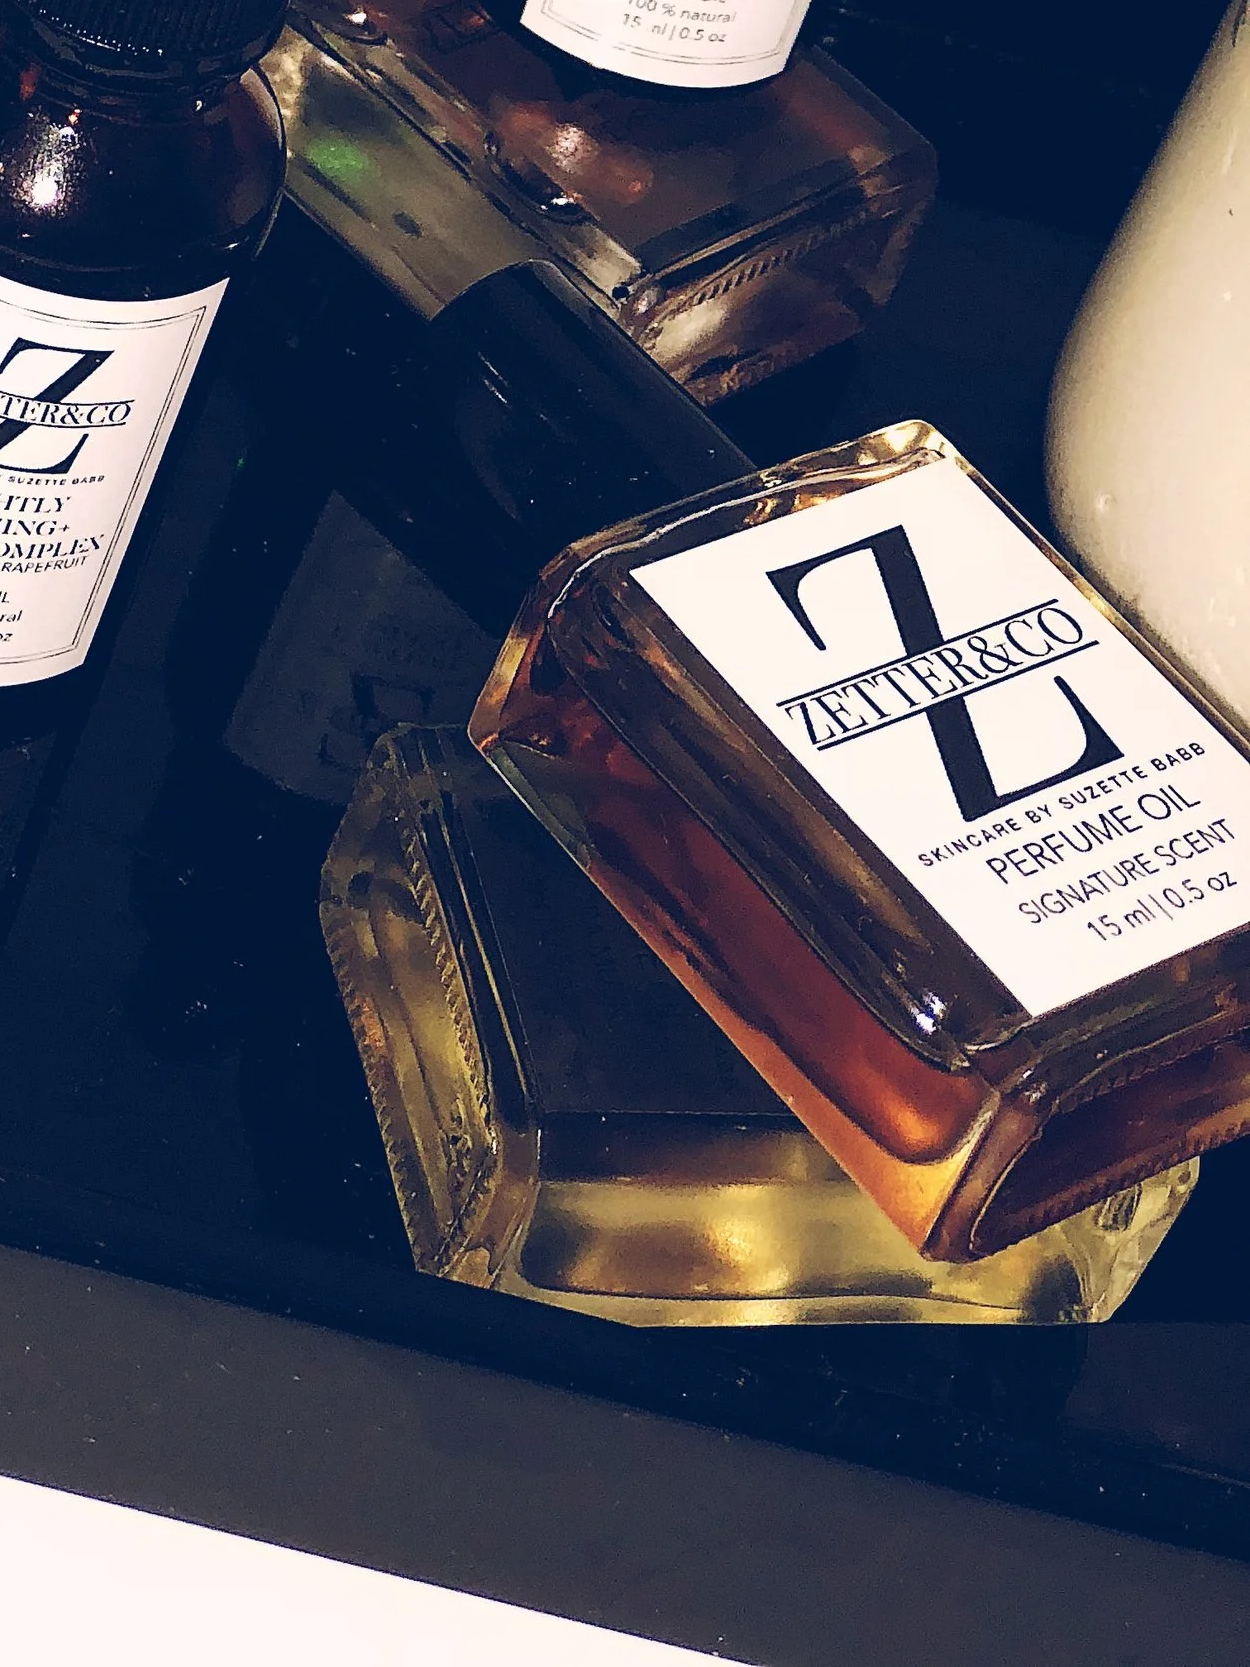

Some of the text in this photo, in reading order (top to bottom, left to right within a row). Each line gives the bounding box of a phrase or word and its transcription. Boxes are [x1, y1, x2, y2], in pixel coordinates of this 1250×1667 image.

[623, 13, 642, 28] 15
[662, 3, 676, 17] %
[680, 10, 737, 24] natural
[8, 475, 67, 486] SUZETTE
[784, 606, 1085, 746] ZETTER&CO
[918, 742, 1206, 867] SKINCARE BY SUZETTE BABB
[985, 784, 1202, 885] PERFUME OIL
[1018, 818, 1235, 924] SIGNATURE SCENT
[1087, 915, 1122, 941] 15
[1124, 899, 1157, 929] ml
[1162, 879, 1205, 909] 0.5
[1207, 871, 1237, 892] oz
